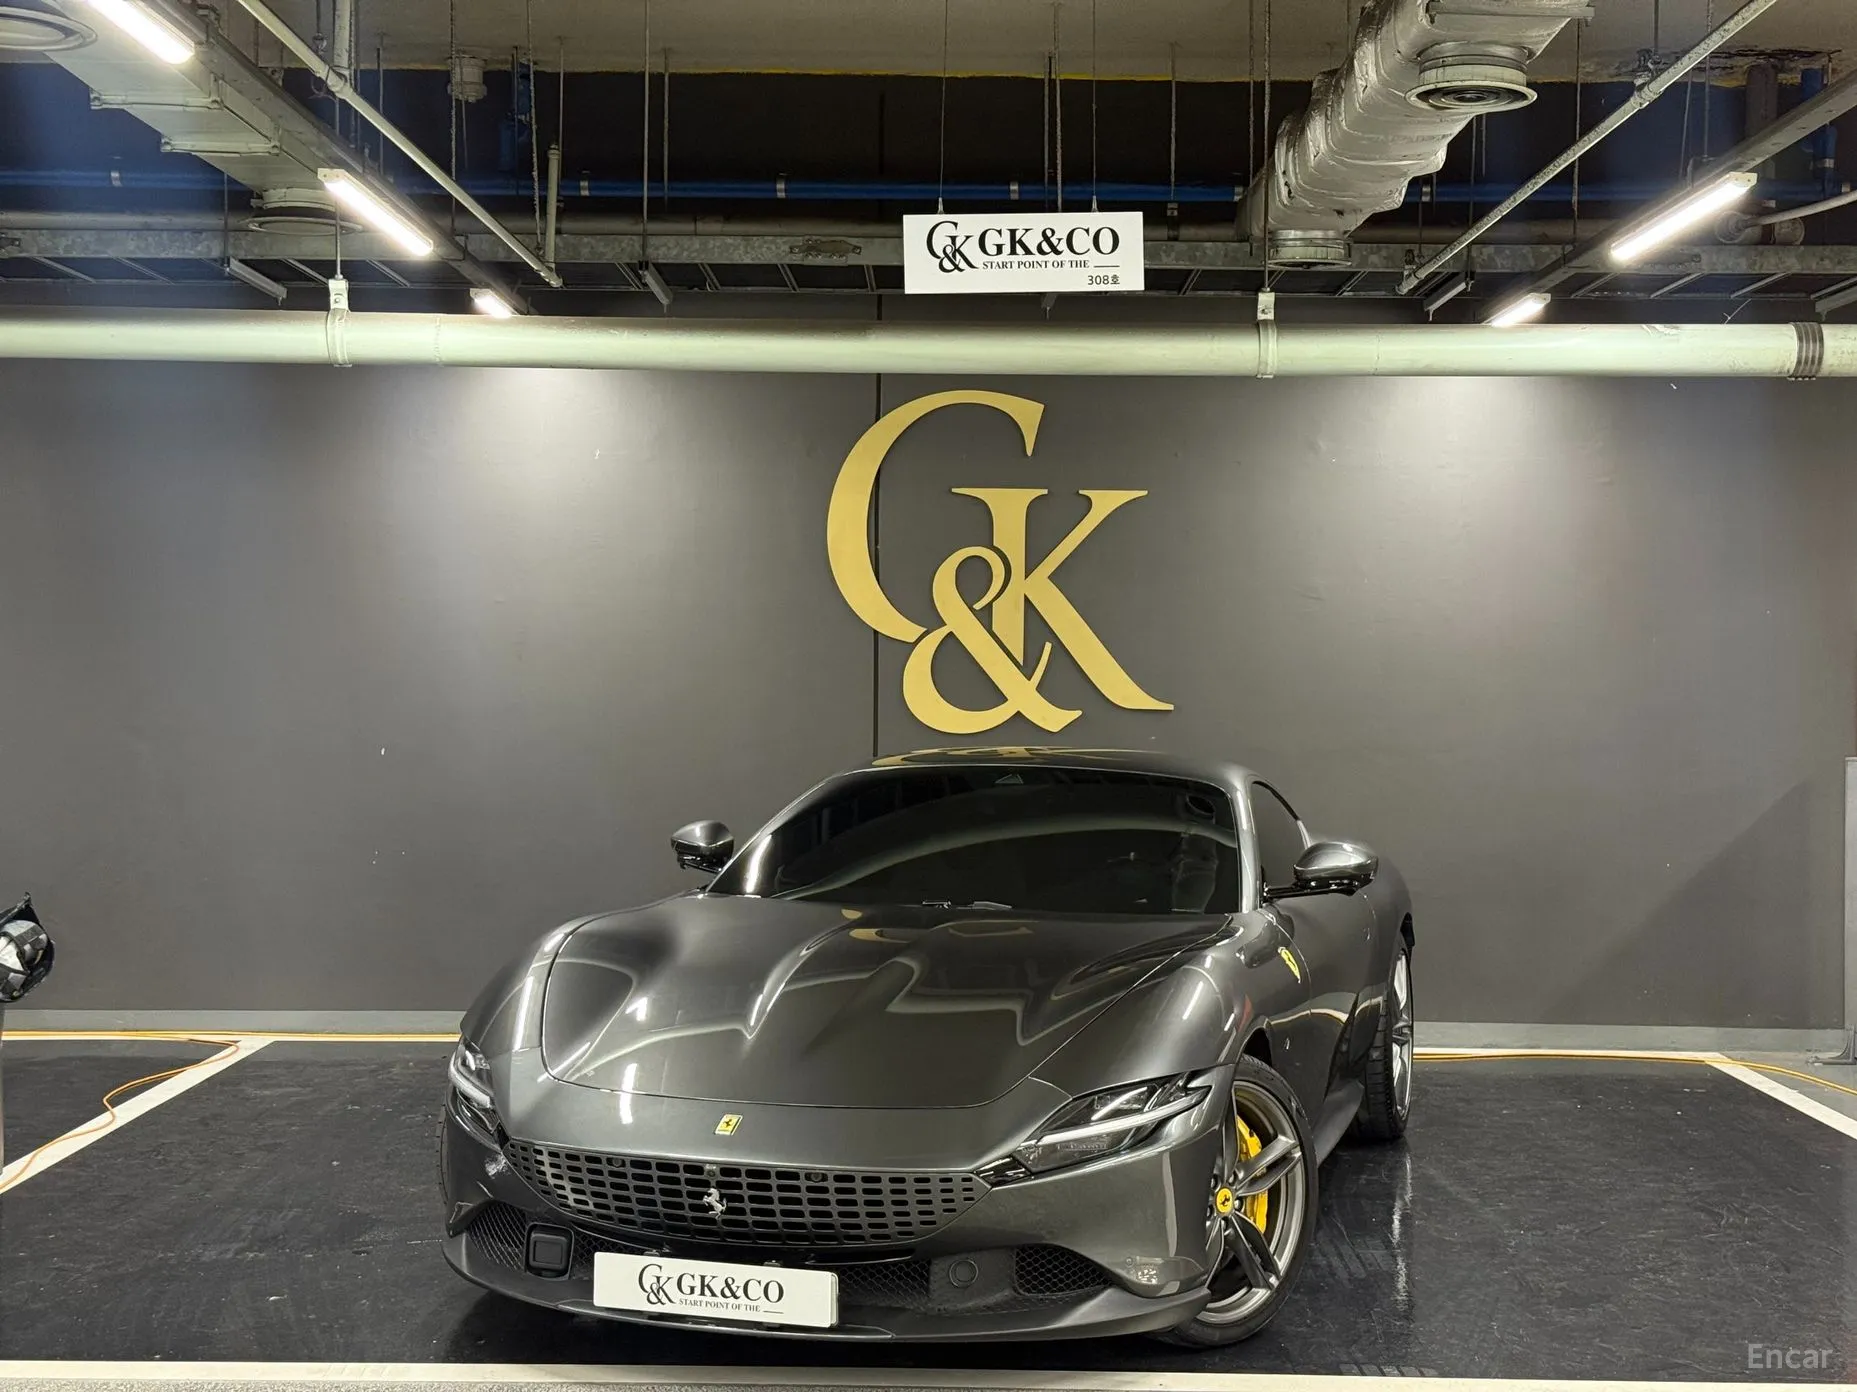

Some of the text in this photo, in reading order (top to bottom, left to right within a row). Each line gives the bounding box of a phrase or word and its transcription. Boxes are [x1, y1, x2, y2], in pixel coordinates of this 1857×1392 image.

[977, 226, 1121, 257] GK&CO
[982, 259, 1090, 270] START POINT OF THE
[1087, 274, 1121, 286] 308호
[676, 1272, 785, 1304] GK&CO
[678, 1298, 761, 1313] START POINT OF THE
